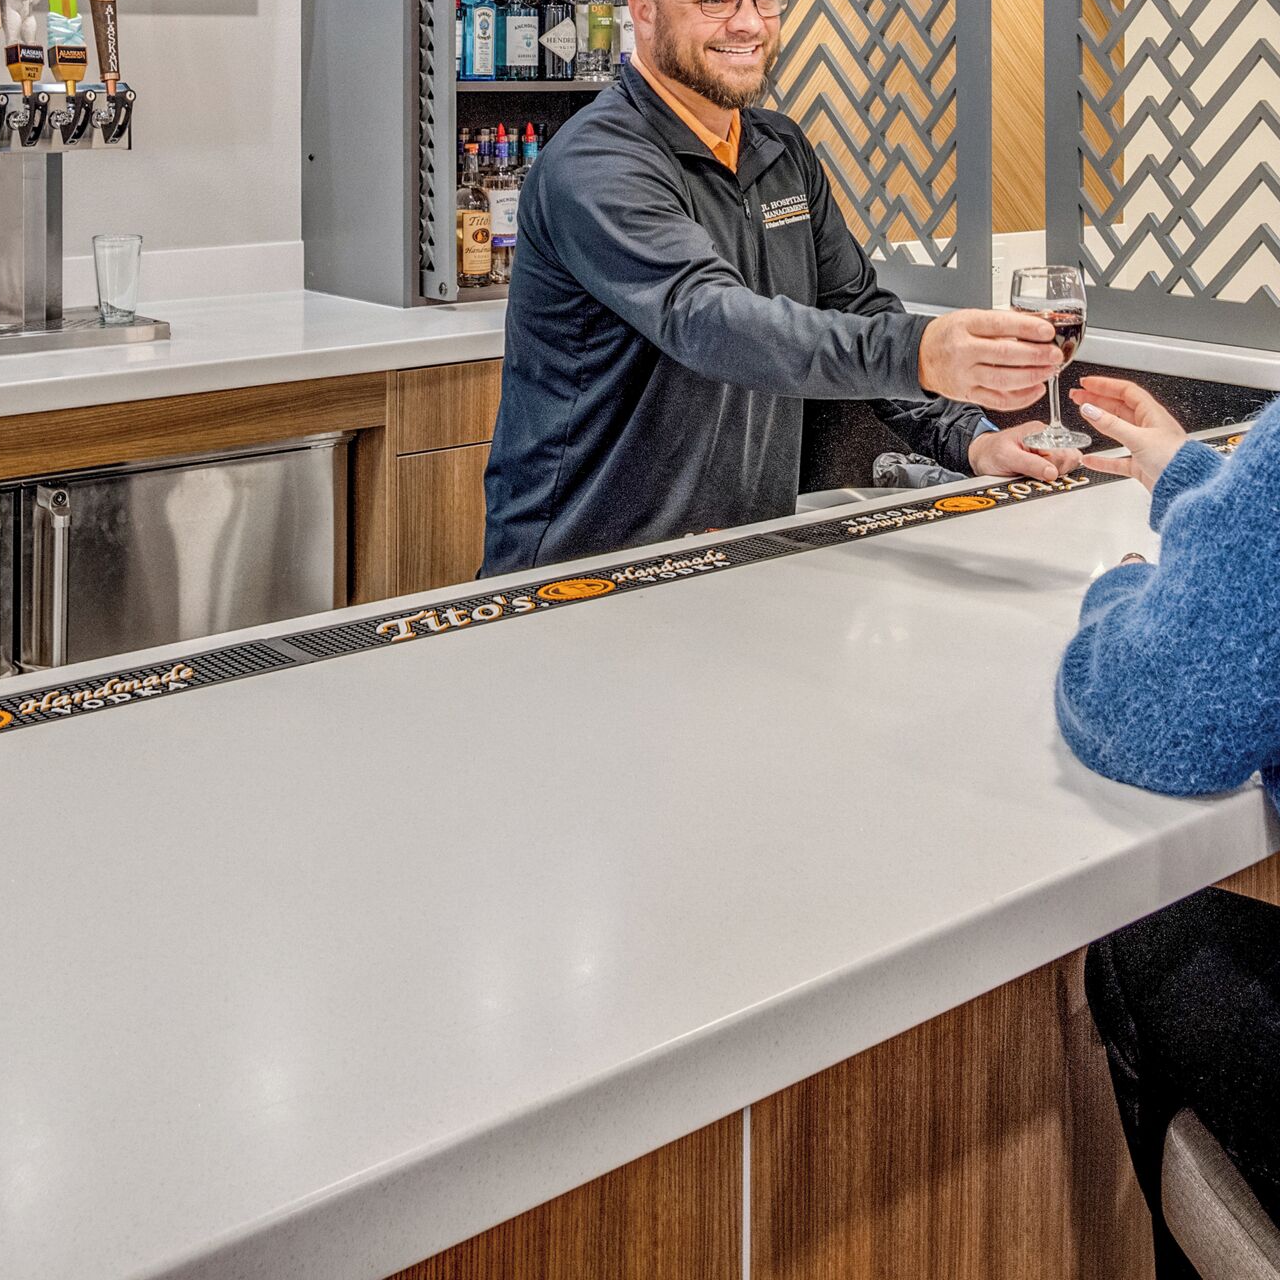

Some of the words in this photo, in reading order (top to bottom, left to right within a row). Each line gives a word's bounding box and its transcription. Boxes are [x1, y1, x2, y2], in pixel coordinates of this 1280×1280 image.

[105, 4, 118, 72] ALASKAN
[20, 48, 44, 59] ALASKAN
[58, 49, 86, 60] ALASKAN
[841, 507, 917, 528] VODKA
[847, 508, 943, 535] Handmade
[612, 549, 726, 583] Handmade
[639, 560, 732, 582] VODKA
[19, 663, 194, 715] Handmade
[50, 681, 189, 715] VODKA
